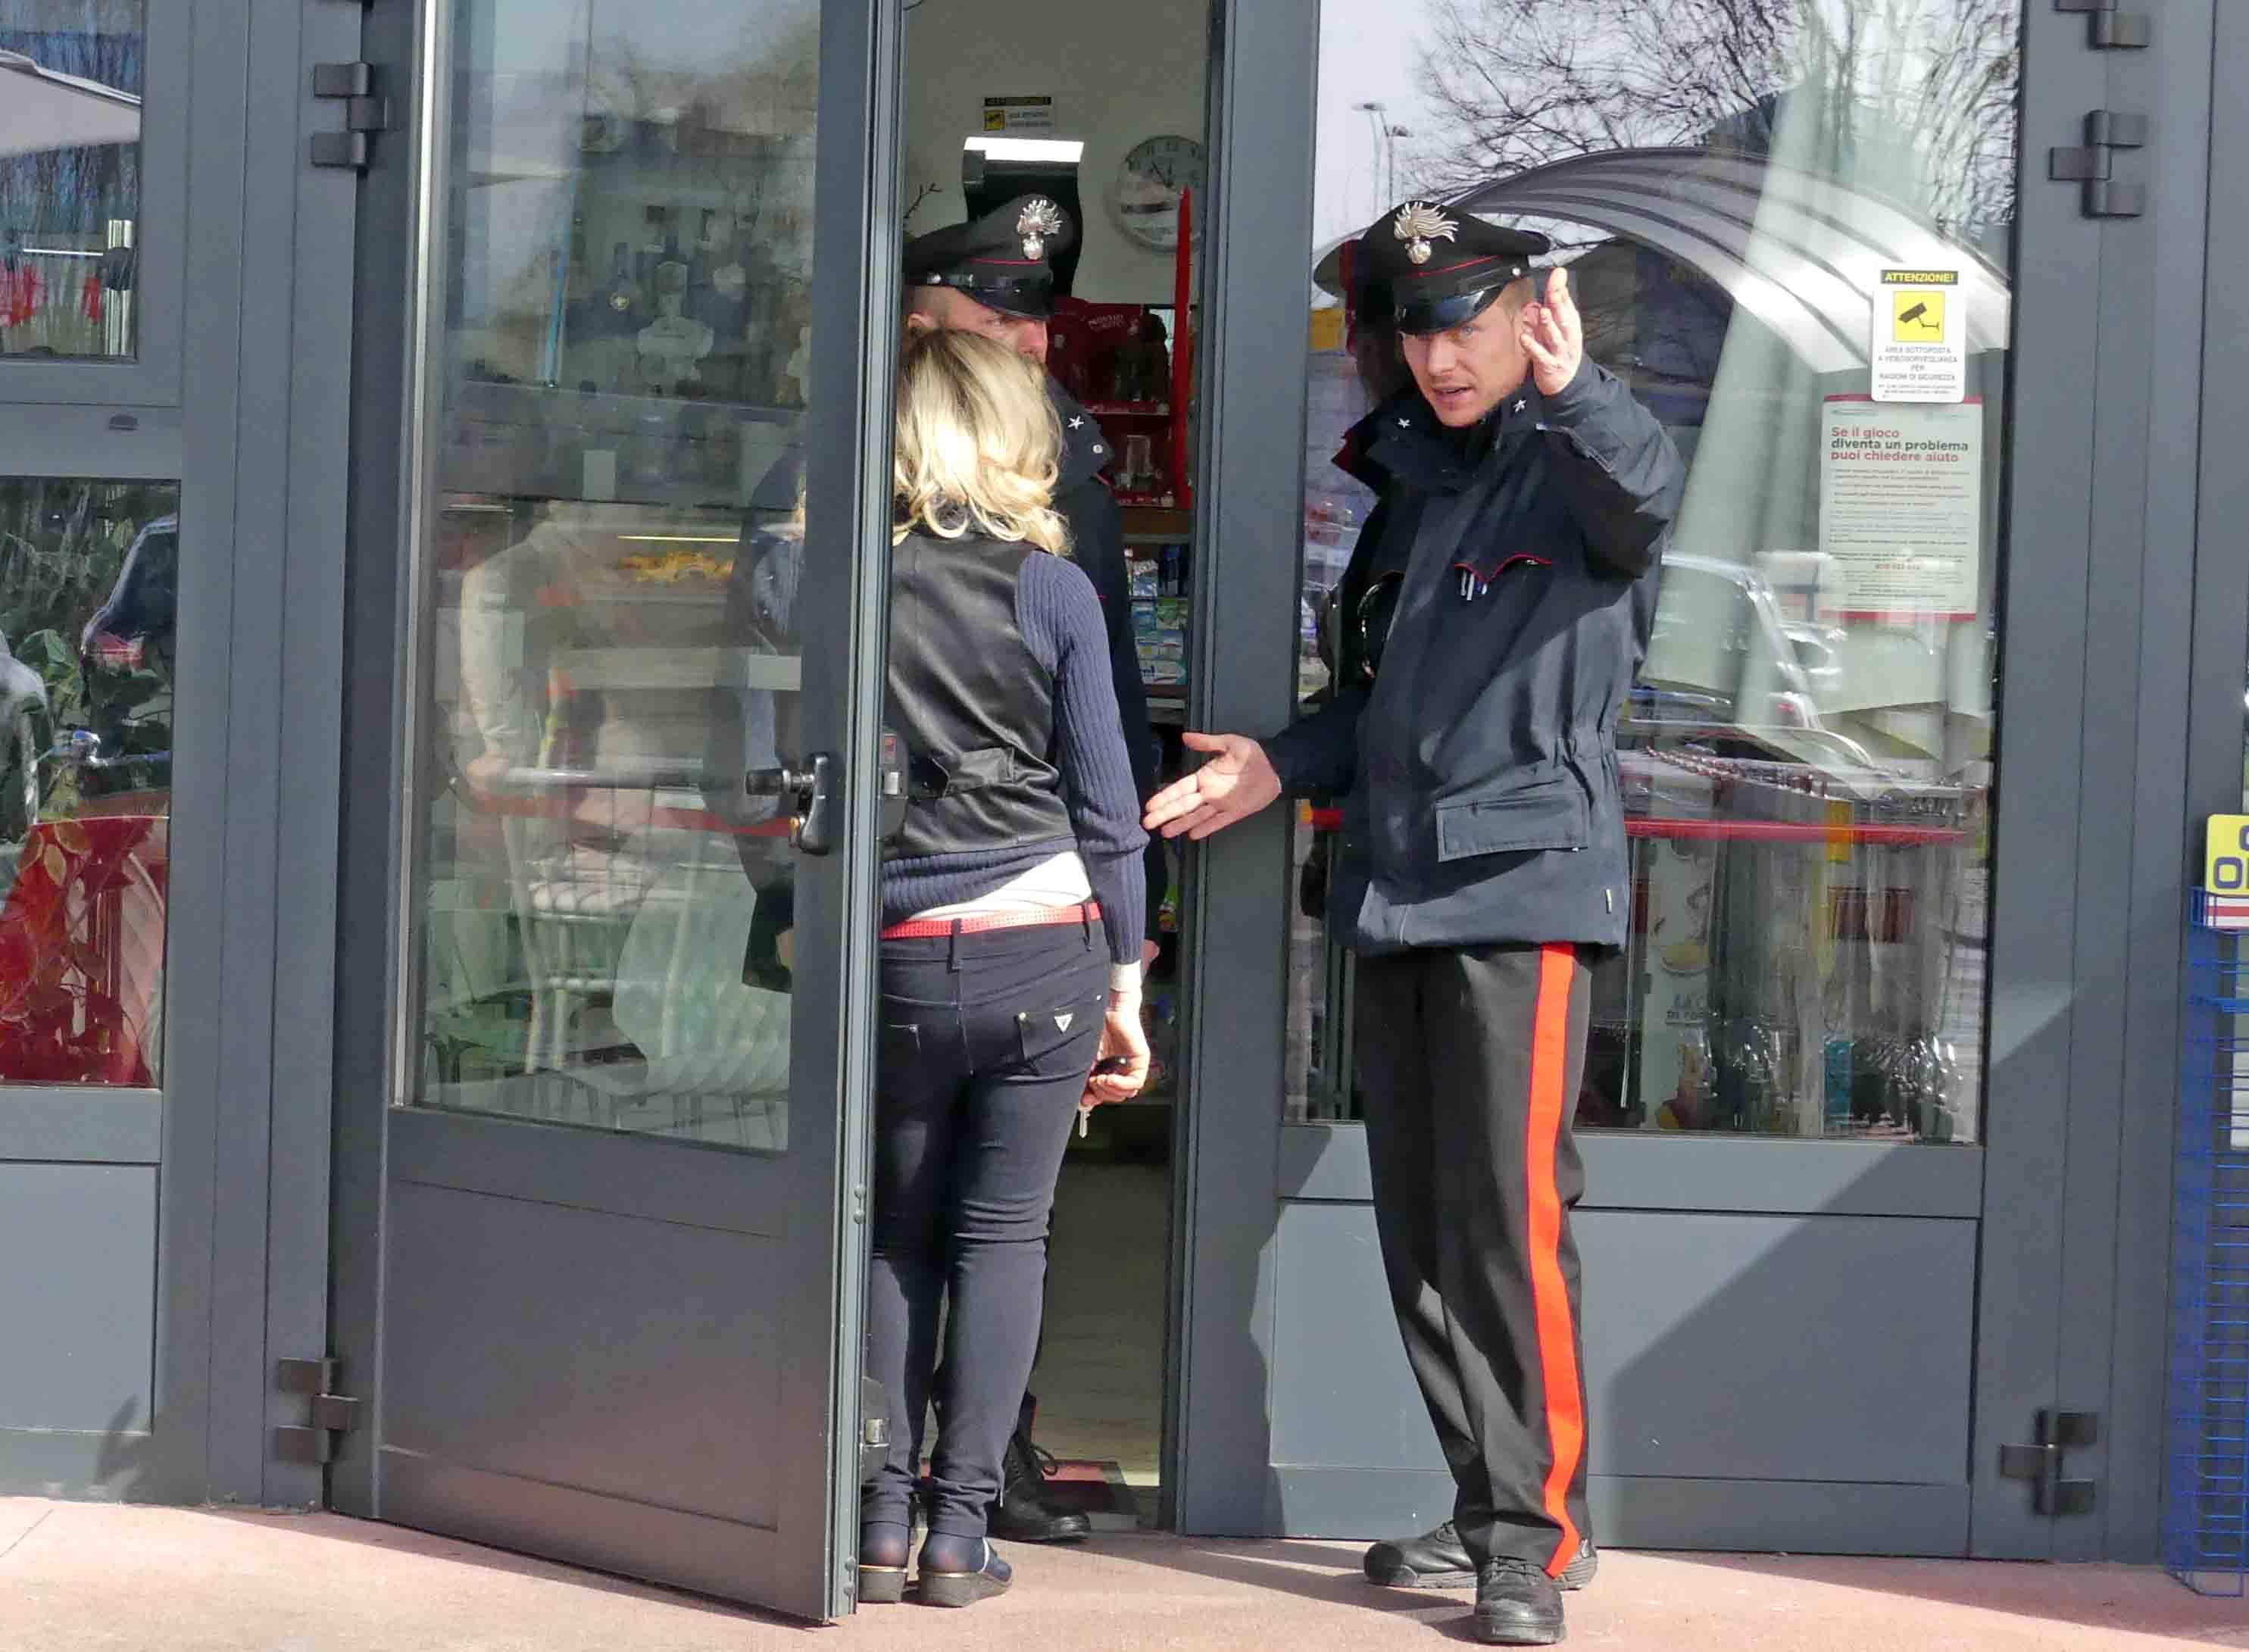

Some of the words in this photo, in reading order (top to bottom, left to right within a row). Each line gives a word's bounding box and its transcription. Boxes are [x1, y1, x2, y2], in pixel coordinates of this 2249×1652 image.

[1884, 273, 1954, 283] ATTENZIONE!
[1831, 426, 1849, 438] Se
[1852, 426, 1860, 438] il
[1863, 427, 1900, 439] gioco
[1831, 439, 1881, 449] diventa
[1885, 441, 1901, 449] un
[1905, 440, 1969, 451] problema
[1830, 450, 1860, 461] puoi
[1865, 451, 1922, 461] chiedere
[1926, 451, 1959, 462] aiuto
